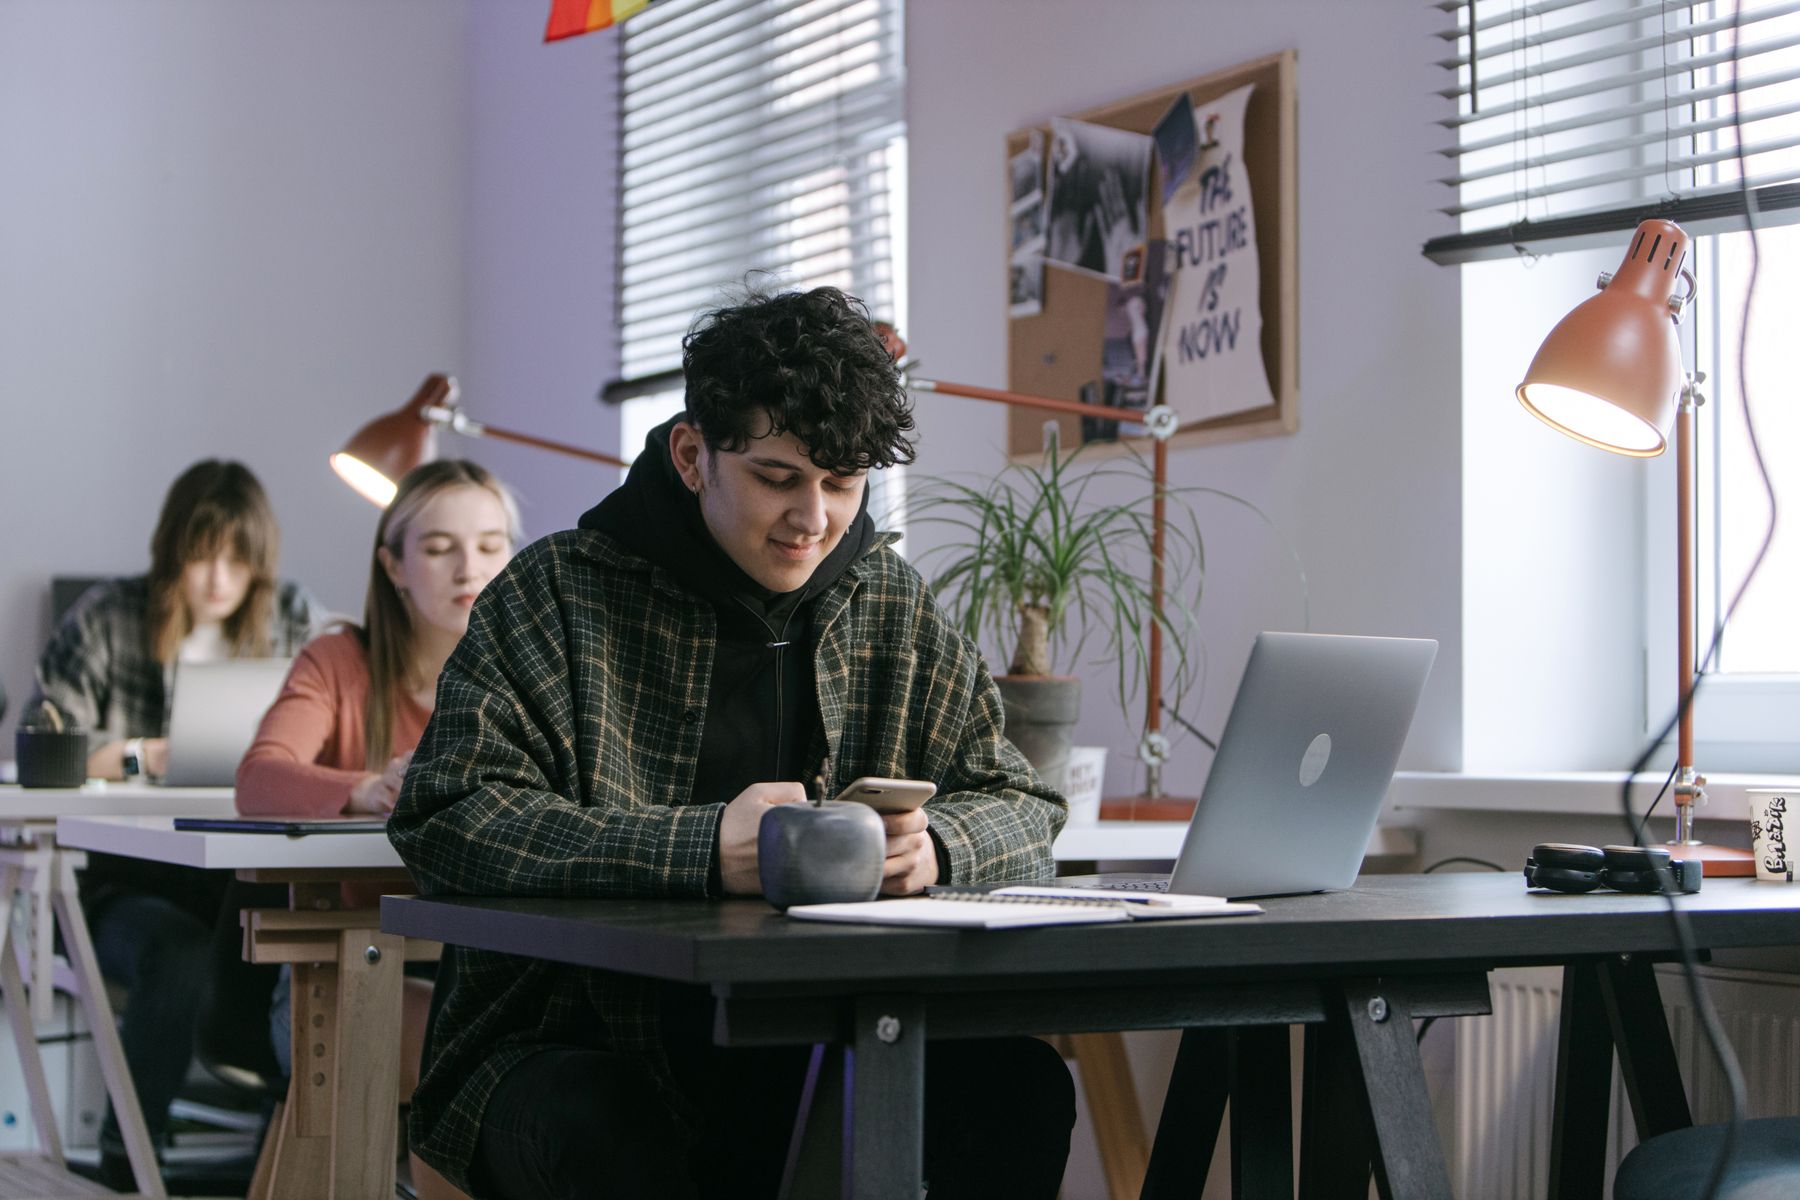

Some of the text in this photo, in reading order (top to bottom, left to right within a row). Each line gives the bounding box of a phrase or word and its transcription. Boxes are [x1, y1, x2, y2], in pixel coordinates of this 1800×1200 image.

[1199, 153, 1233, 215] THE
[1175, 206, 1248, 268] FUTURE
[1197, 263, 1228, 313] IS
[1177, 308, 1242, 365] NOW
